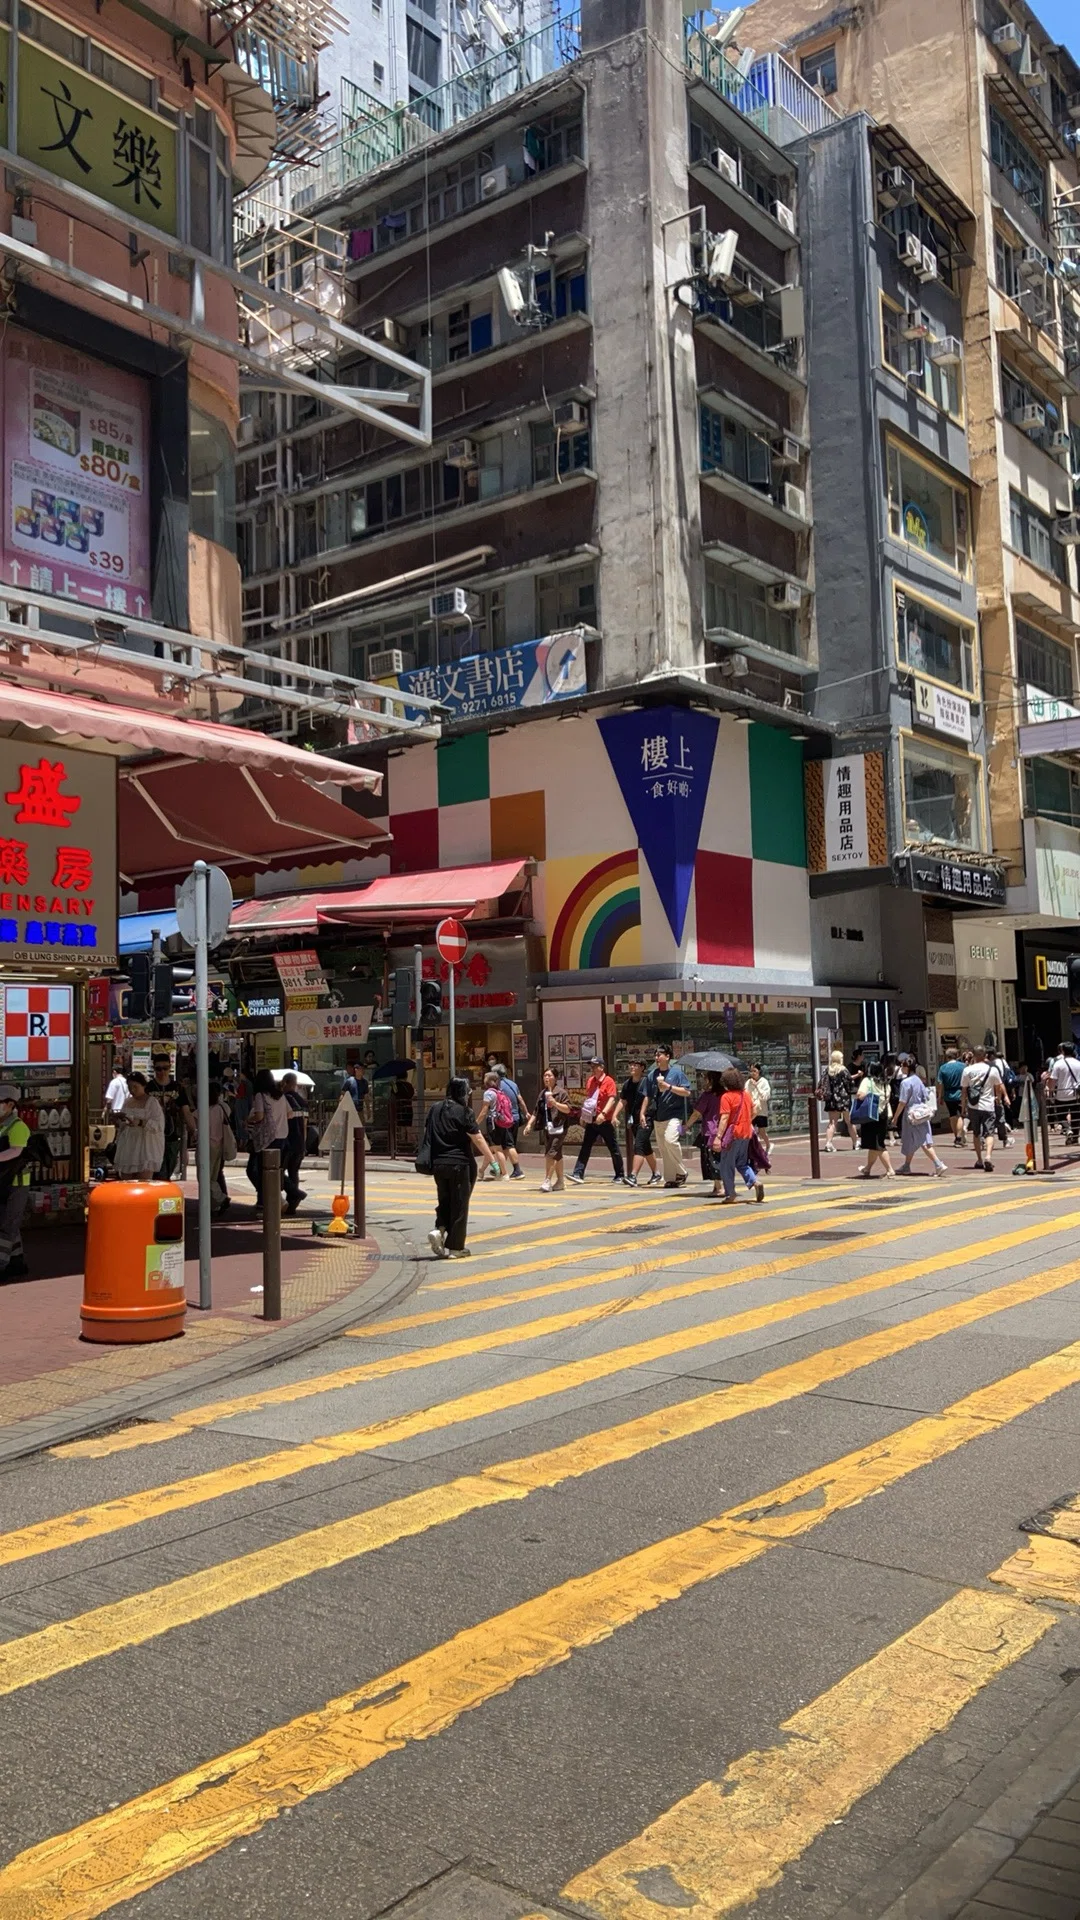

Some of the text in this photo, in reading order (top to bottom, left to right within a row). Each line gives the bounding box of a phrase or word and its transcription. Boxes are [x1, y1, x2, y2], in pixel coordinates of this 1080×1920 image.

[38, 79, 162, 210] 文樂
[89, 551, 124, 573] $39
[30, 564, 127, 614] 請上一樓
[462, 698, 487, 714] 9271
[491, 692, 517, 707] 6815
[640, 735, 694, 772] 樓上
[5, 757, 82, 828] 盛
[836, 765, 854, 851] 情趣用品店
[0, 836, 94, 892] 藥房
[831, 851, 864, 862] SEXTOY
[940, 864, 993, 898] 情趣用品店
[0, 892, 96, 916] ENSARY
[29, 952, 52, 961] LUNG
[53, 953, 76, 962] SHING
[77, 955, 103, 963] PLAZA
[103, 956, 117, 964] LTD
[282, 978, 303, 988] 9811
[237, 1001, 281, 1017] EXCHANGE
[247, 998, 280, 1007] HONG ONG
